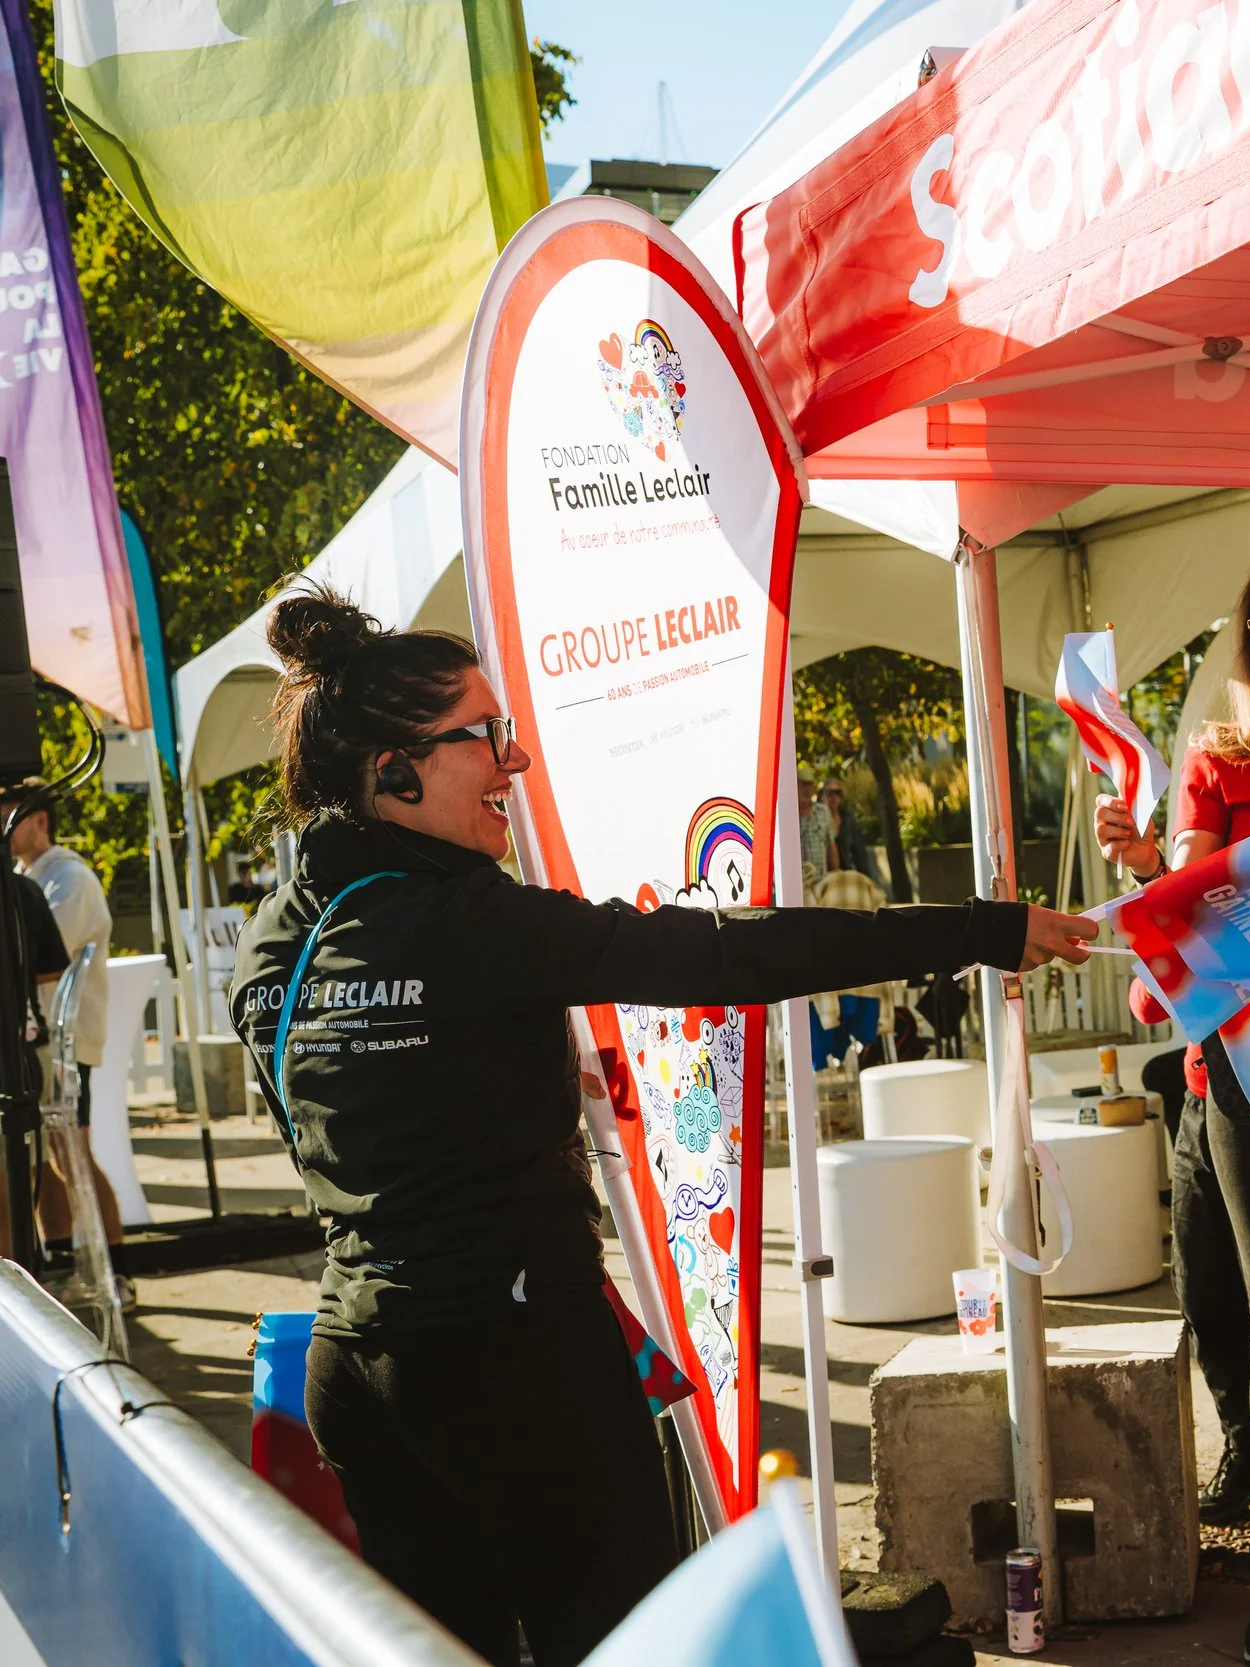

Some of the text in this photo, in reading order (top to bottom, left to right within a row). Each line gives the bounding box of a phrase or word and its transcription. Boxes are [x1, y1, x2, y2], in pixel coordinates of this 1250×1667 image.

[541, 444, 630, 468] FONDATION
[548, 464, 711, 511] Famille Leclair
[561, 513, 721, 551] Au coeur de notre communauté
[540, 596, 741, 677] GROUPE LECLAIR
[607, 688, 617, 700] 60
[617, 684, 633, 699] ANS
[642, 673, 670, 693] PASSION
[670, 660, 710, 682] AUTOMOBILE
[608, 739, 646, 758] HONDA
[246, 979, 424, 1012] GROPE LECLAIR
[328, 1020, 369, 1029] AUTOMOBILE
[306, 1043, 342, 1053] HYUNDAI
[367, 1035, 429, 1051] SUBARU
